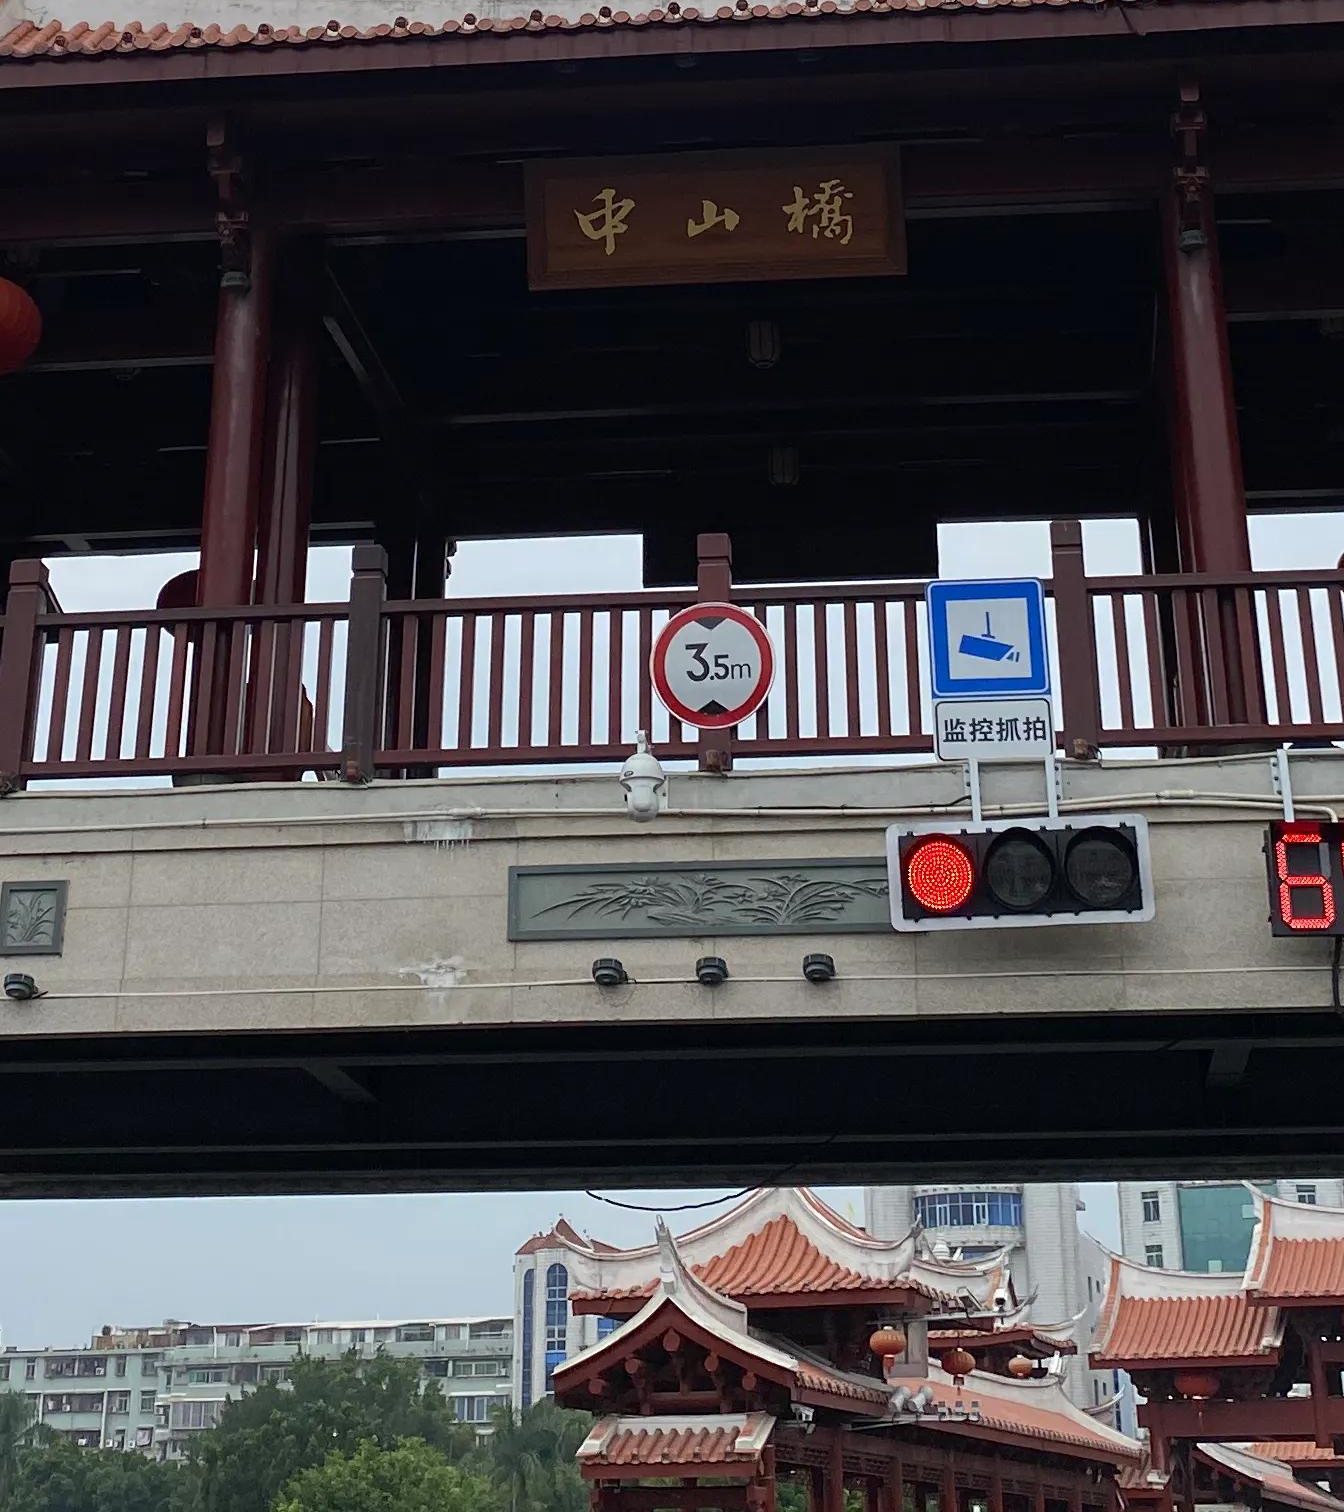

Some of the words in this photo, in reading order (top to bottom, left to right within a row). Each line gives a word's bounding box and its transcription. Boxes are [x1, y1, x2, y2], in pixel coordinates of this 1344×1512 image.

[574, 179, 854, 256] 中山橋
[685, 642, 752, 682] 3.5m
[942, 716, 1047, 743] 监控抓拍
